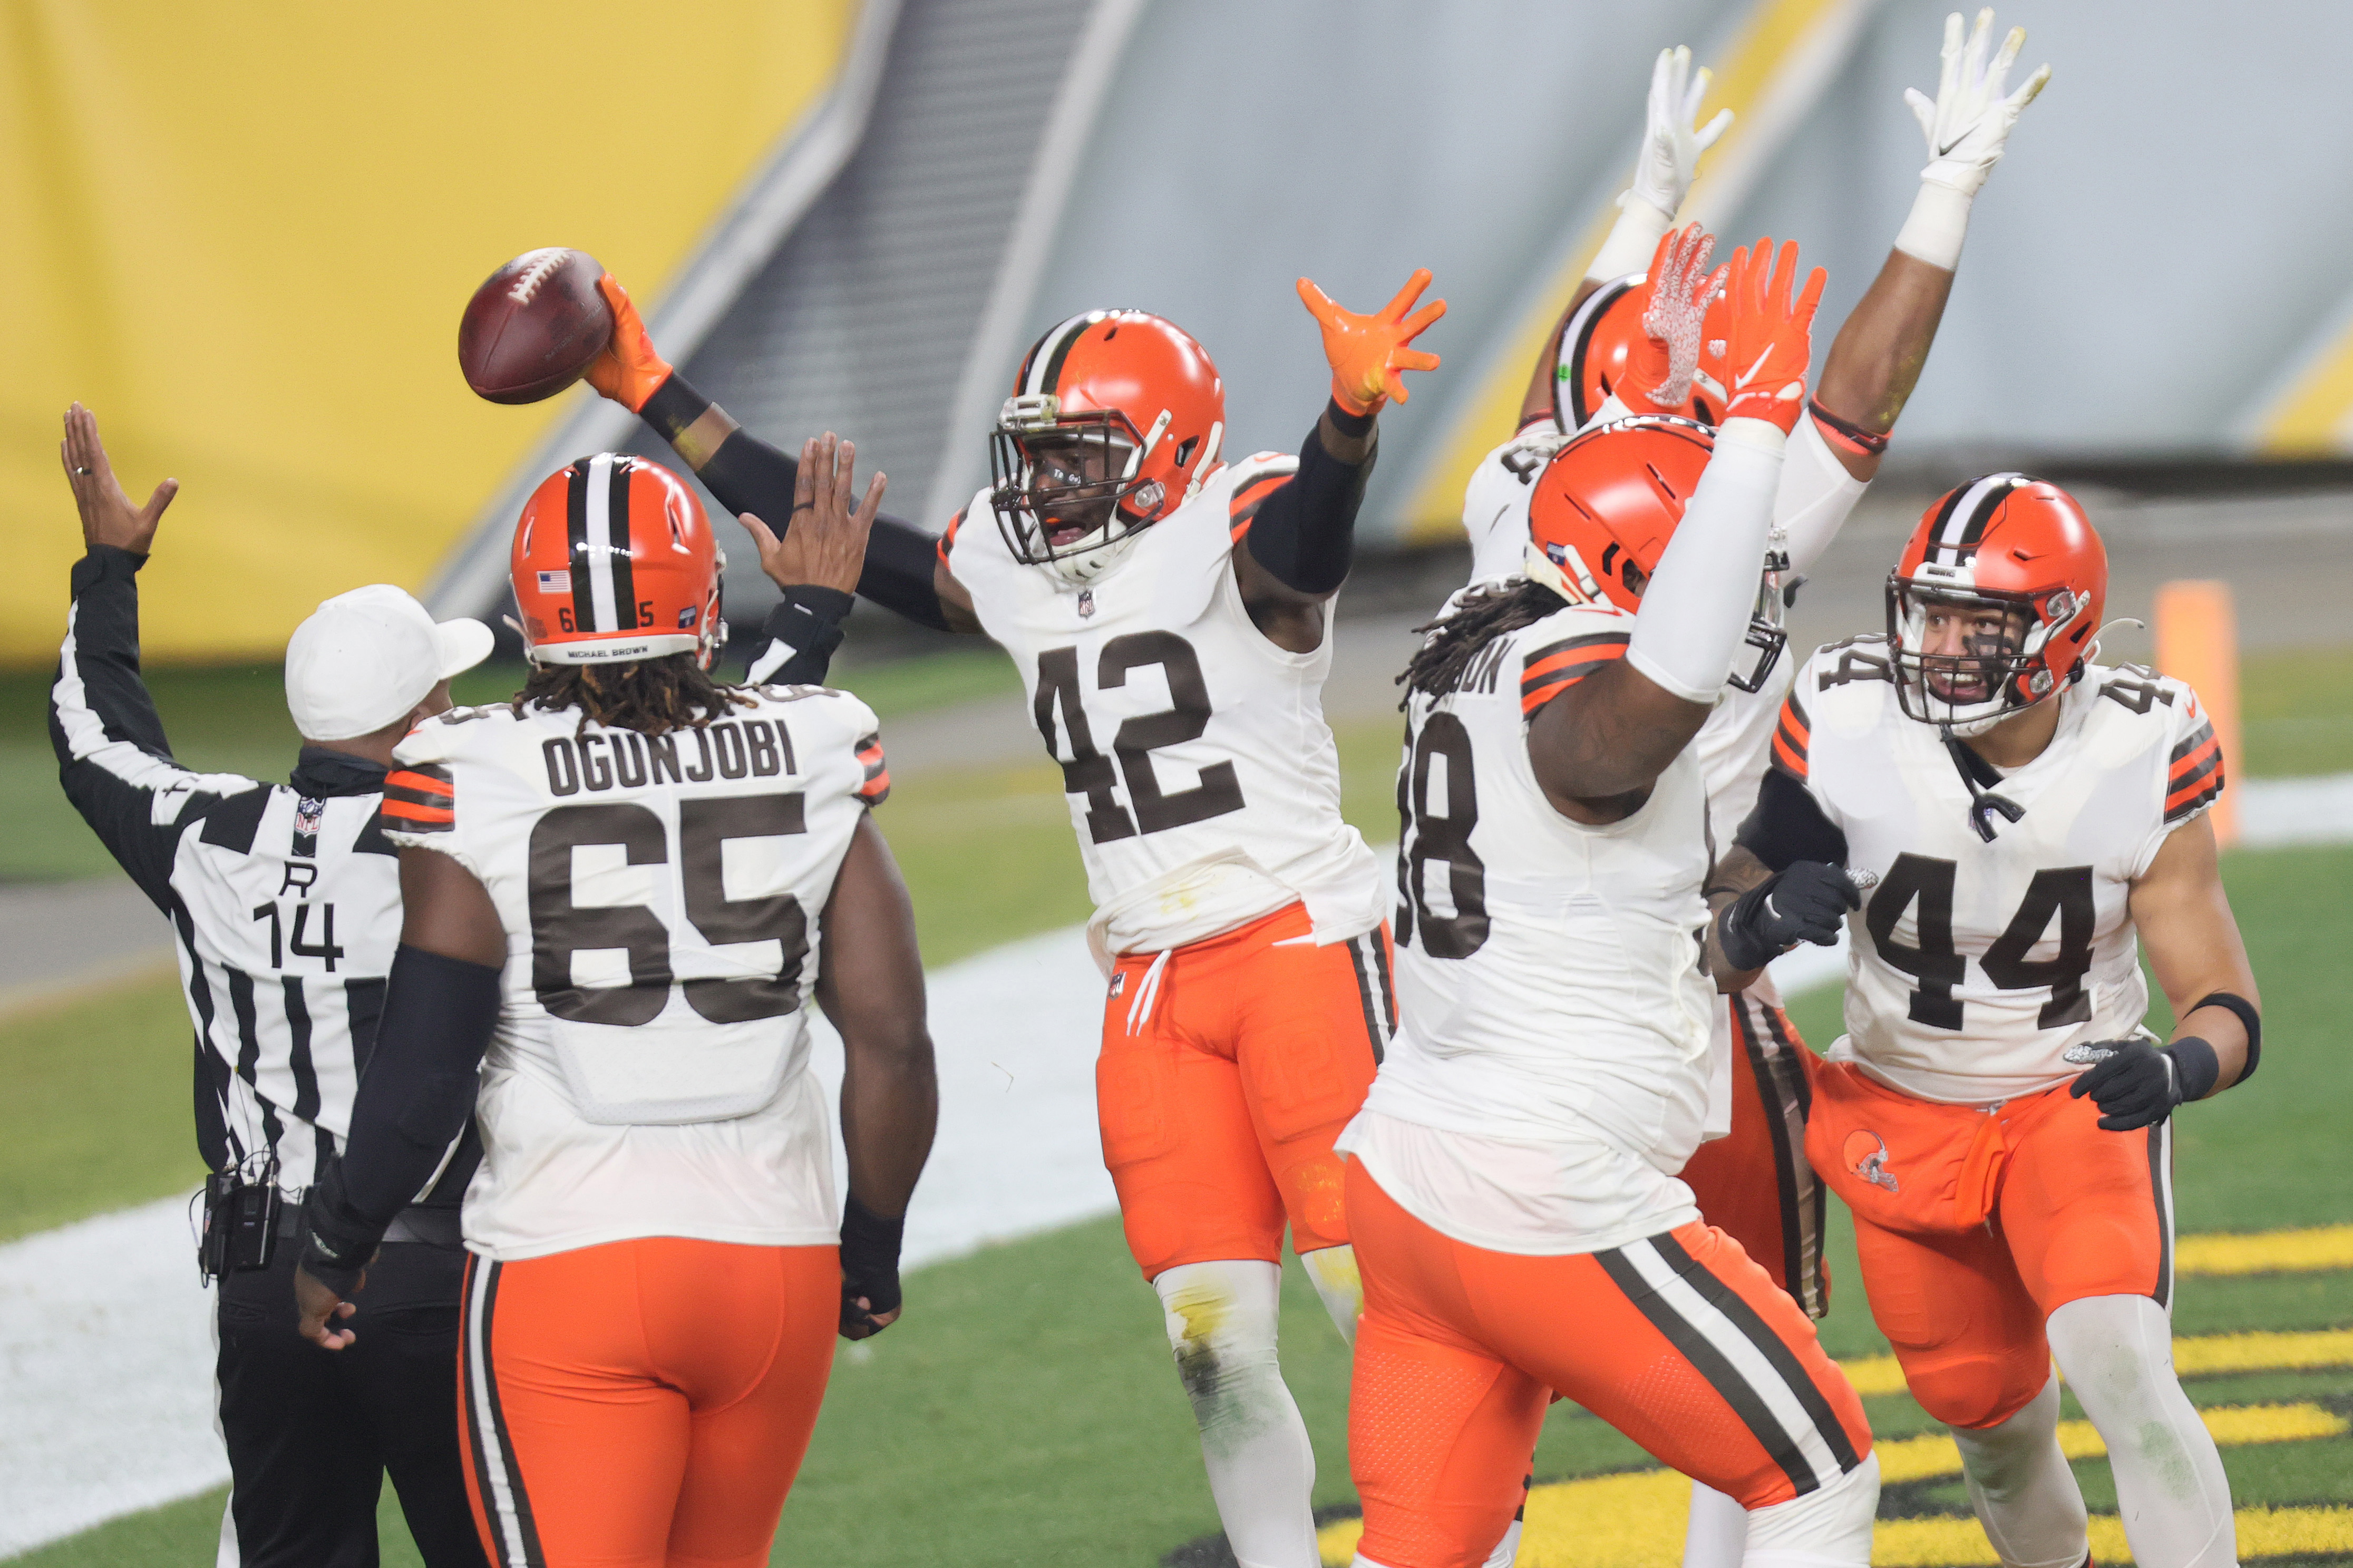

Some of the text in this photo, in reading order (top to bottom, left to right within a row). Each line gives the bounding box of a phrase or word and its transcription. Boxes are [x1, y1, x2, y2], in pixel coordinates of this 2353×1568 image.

[567, 645, 648, 658] MICHAEL BROWN
[542, 718, 798, 797] OGUNJOBI
[1034, 629, 1246, 845] 42
[278, 860, 318, 898] R
[529, 792, 810, 1027] 65
[253, 900, 345, 972] 14
[1866, 852, 2096, 1031] 44
